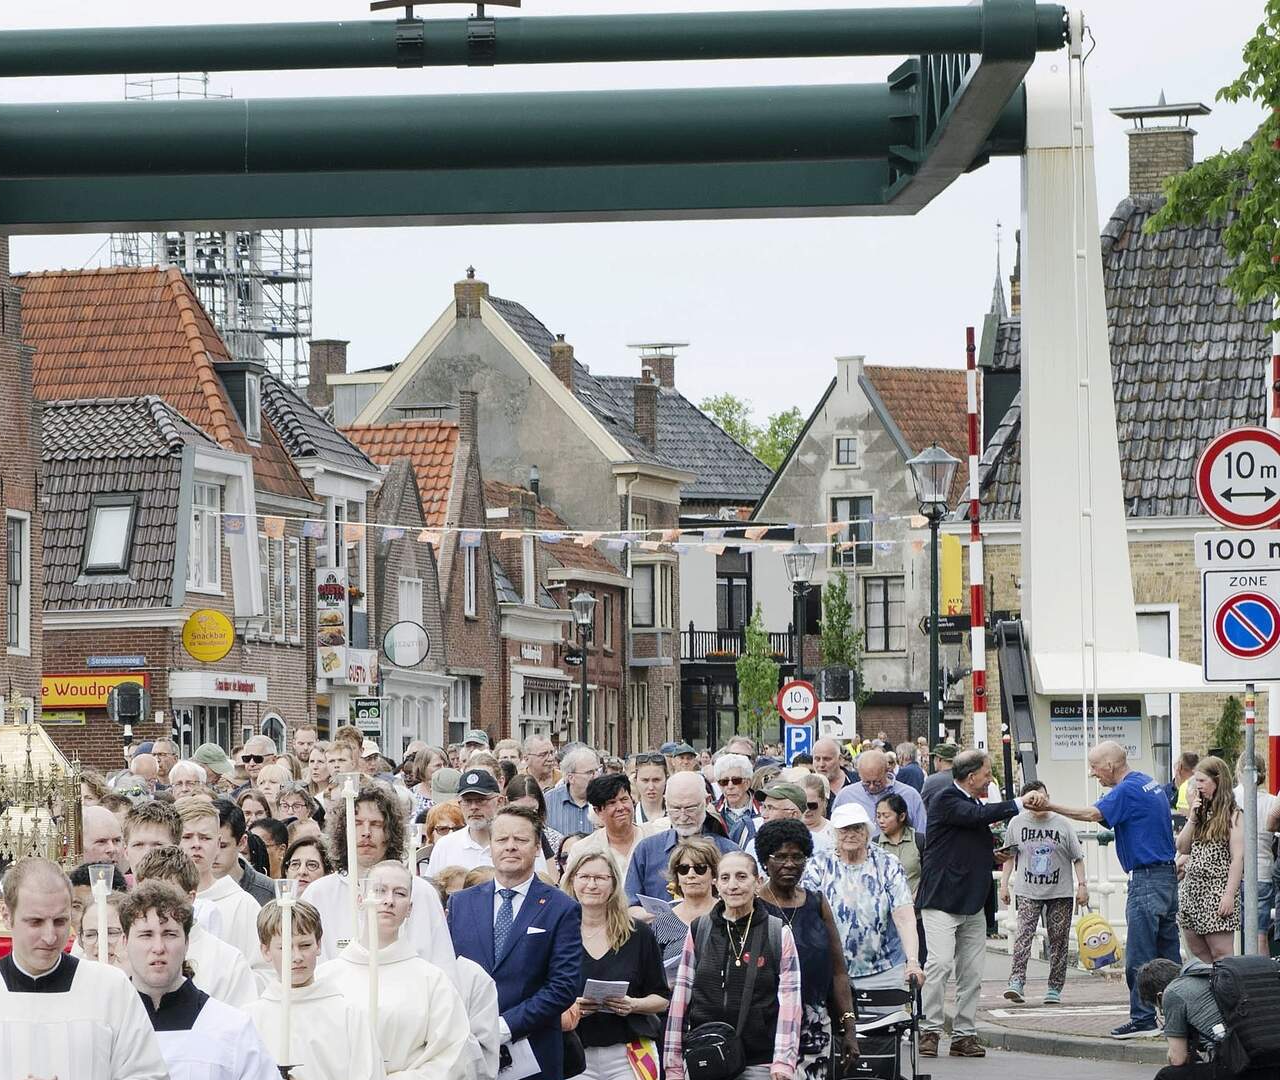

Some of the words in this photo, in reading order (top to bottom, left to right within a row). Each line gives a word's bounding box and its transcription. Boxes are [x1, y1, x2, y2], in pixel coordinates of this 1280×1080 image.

[1225, 451, 1255, 479] 10
[1260, 465, 1277, 479] m
[1204, 538, 1256, 561] 100
[1229, 576, 1268, 587] ZONE
[191, 631, 226, 640] Snackbar
[348, 665, 367, 683] GUSTO
[790, 691, 801, 703] 10
[1054, 706, 1076, 714] GEEN
[1021, 826, 1061, 844] OHANA
[1024, 868, 1061, 886] STITCH
